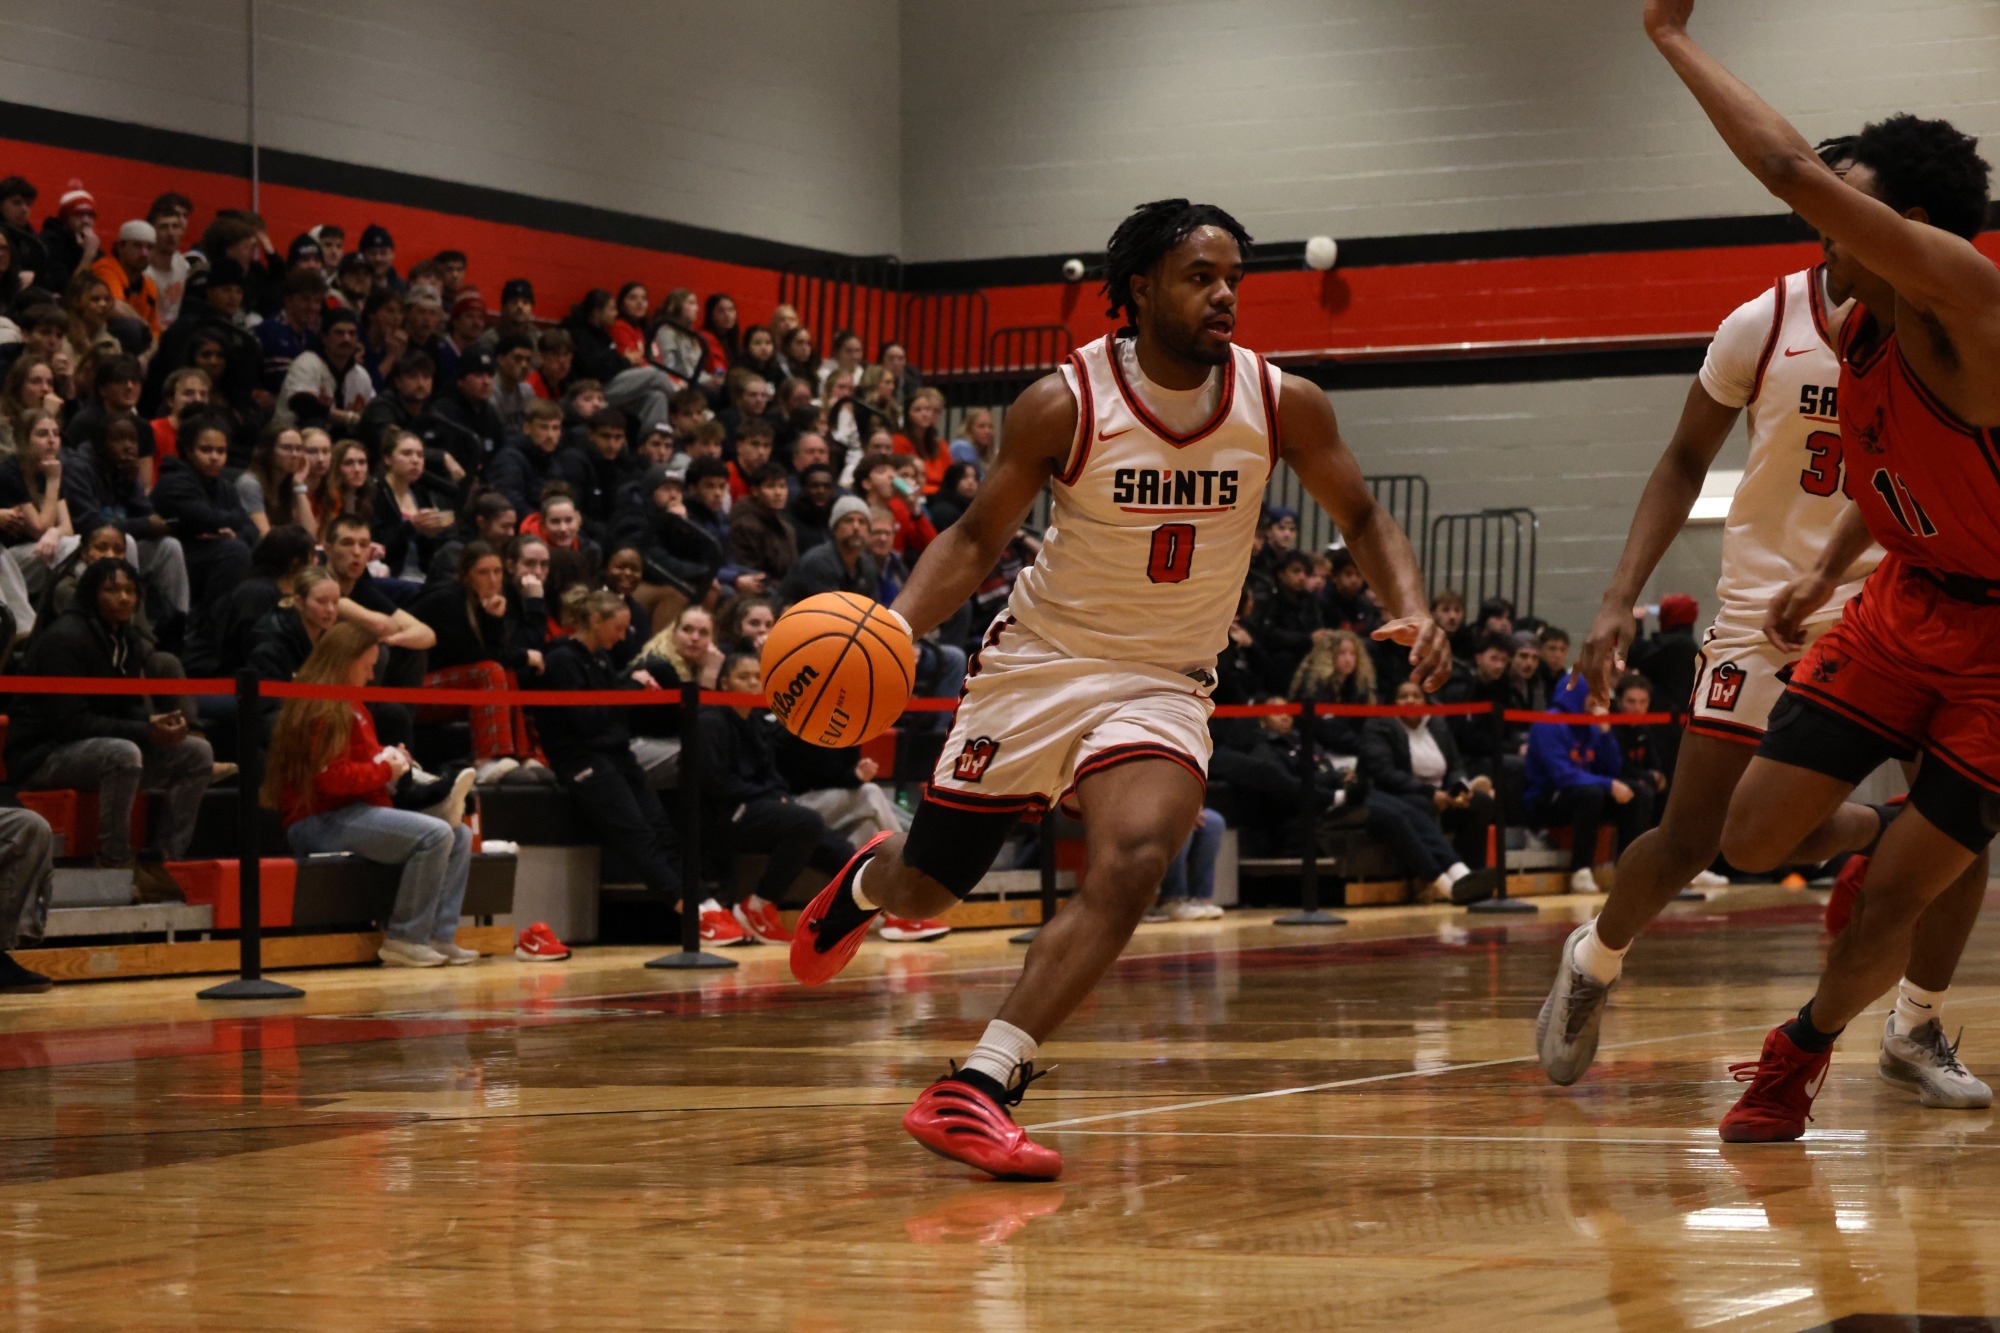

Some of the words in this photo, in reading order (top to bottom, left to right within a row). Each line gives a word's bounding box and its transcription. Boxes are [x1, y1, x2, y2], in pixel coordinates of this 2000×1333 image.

[1113, 468, 1238, 506] SAINTS
[1800, 430, 1856, 501] 3
[1871, 467, 1938, 538] 11
[1147, 523, 1196, 583] 0
[770, 664, 820, 725] ilson
[1710, 682, 1737, 703] DY
